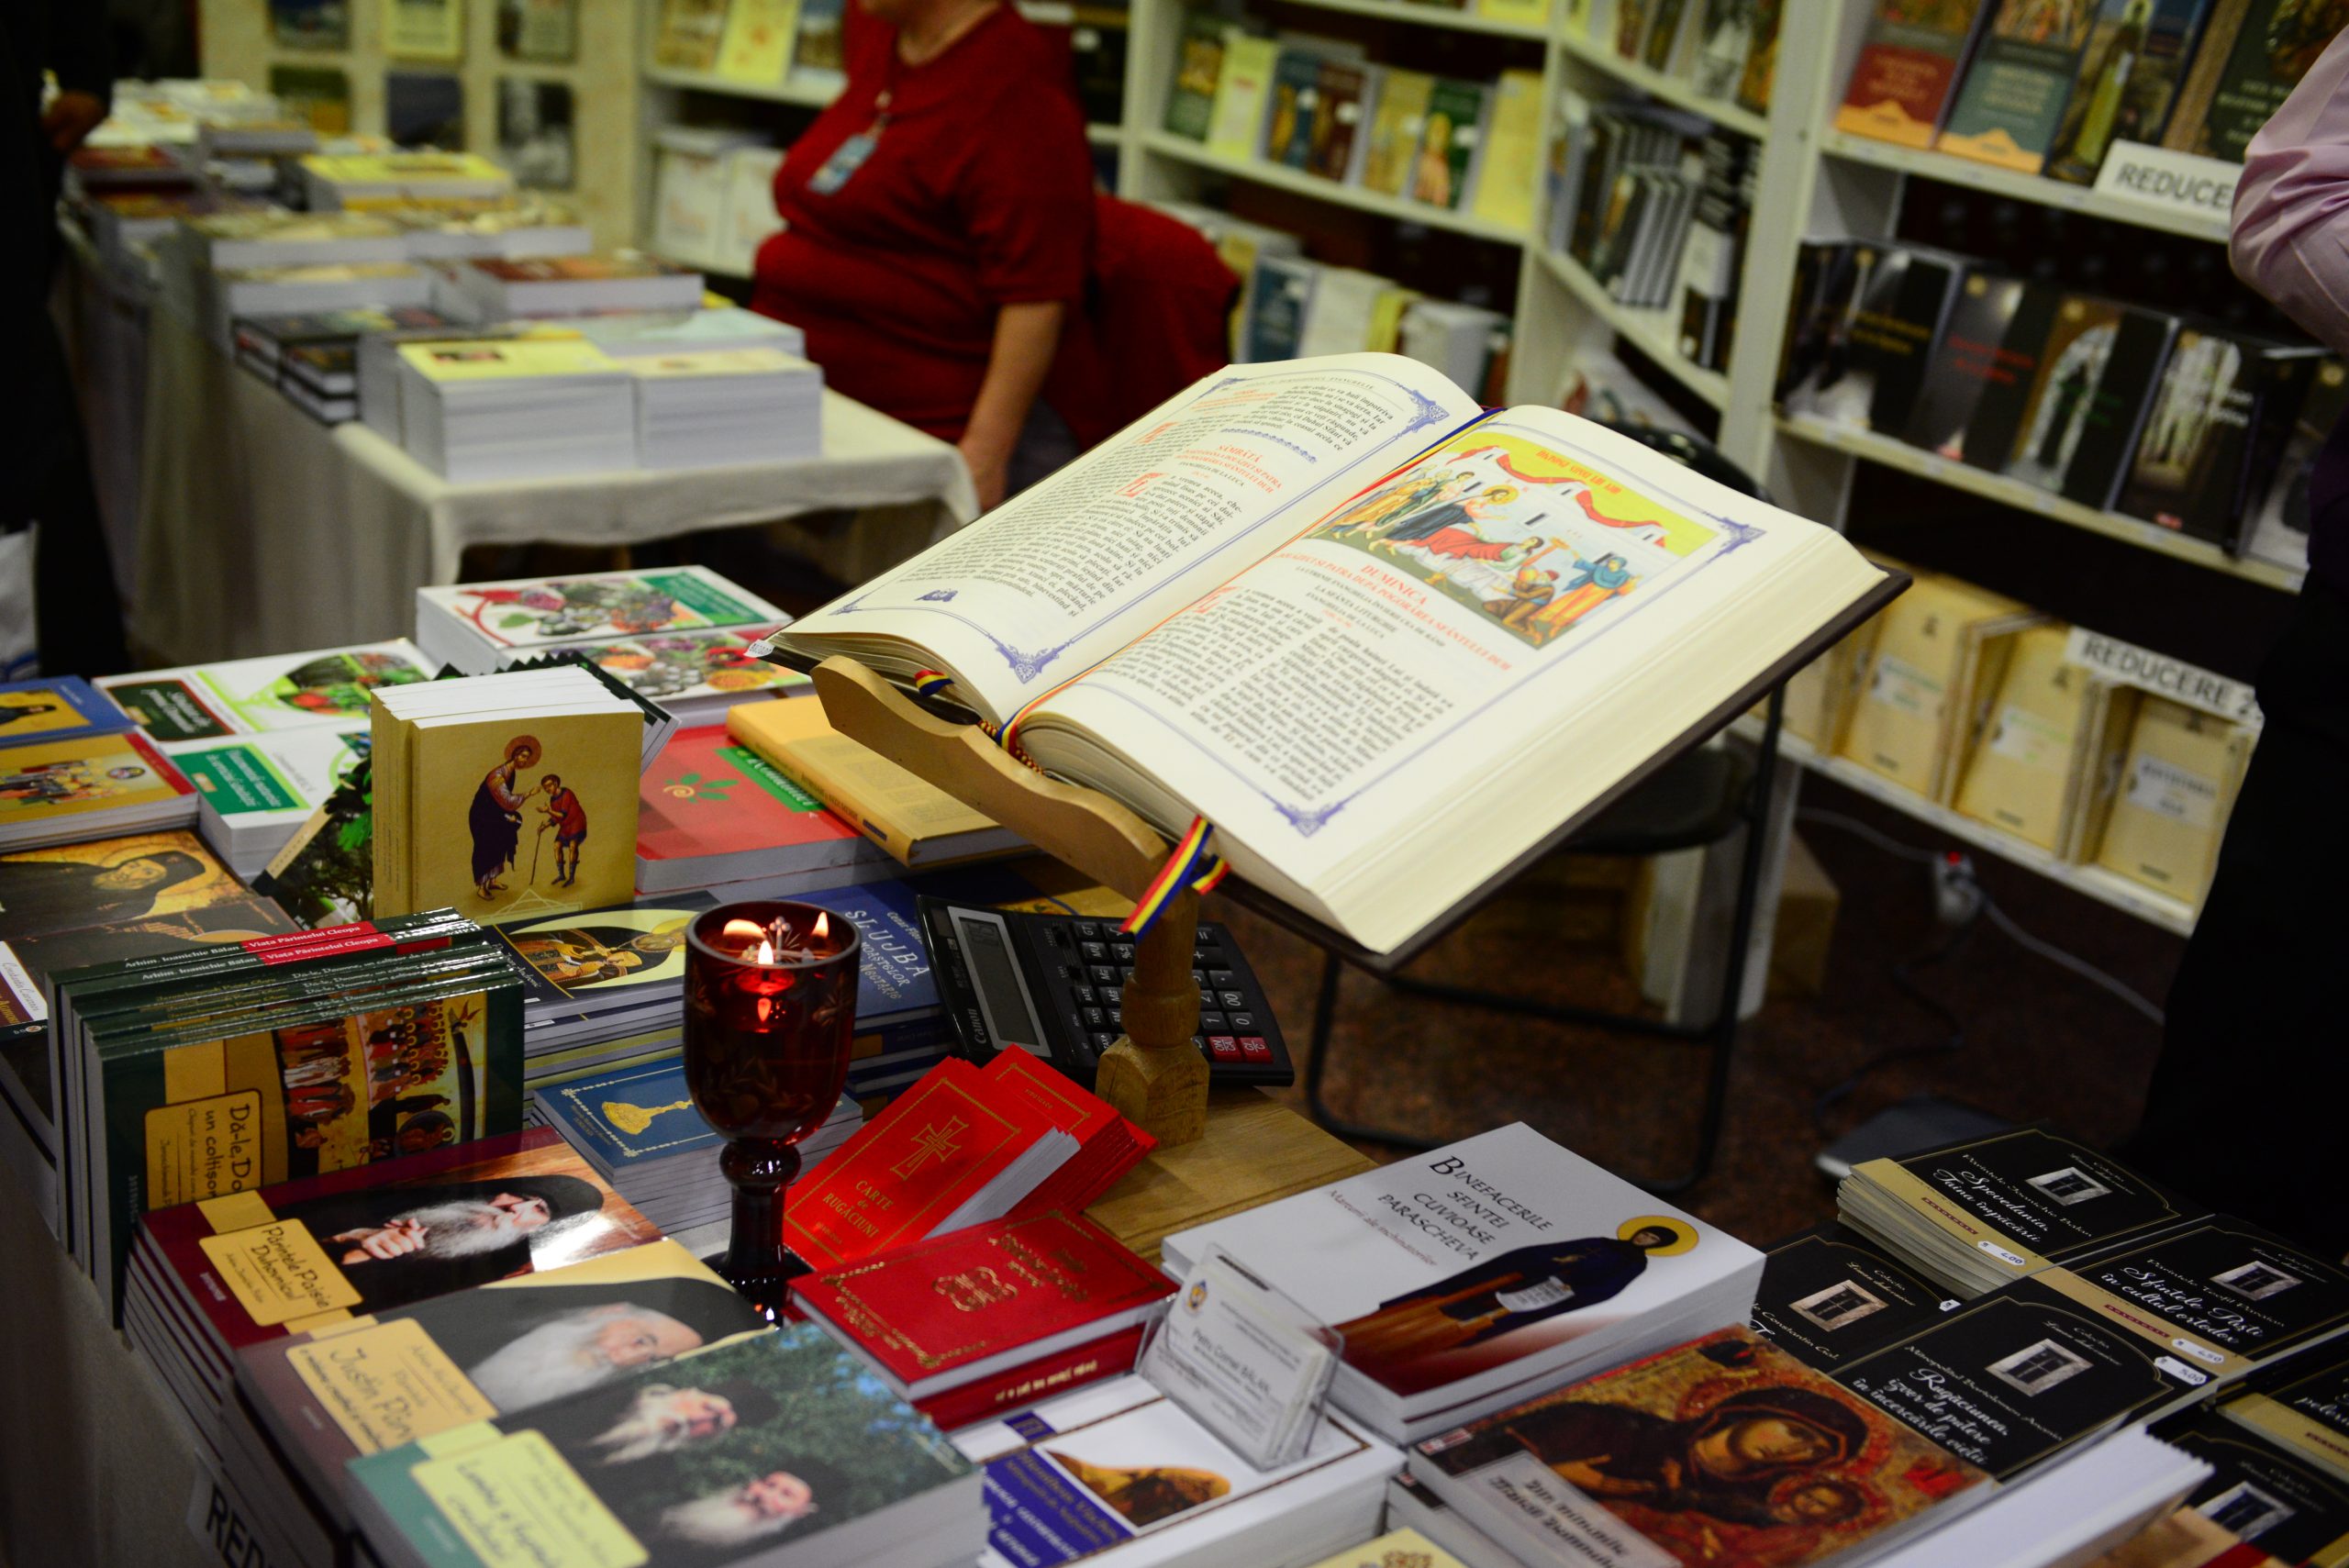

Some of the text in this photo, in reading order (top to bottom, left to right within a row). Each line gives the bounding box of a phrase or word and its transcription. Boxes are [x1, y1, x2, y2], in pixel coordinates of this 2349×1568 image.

[2118, 160, 2233, 209] REDUCE
[1102, 583, 1115, 594] din
[162, 949, 208, 966] Ioanichie
[327, 926, 361, 940] Cleopa
[345, 937, 379, 951] Cleopa
[845, 910, 930, 977] SLUJBA
[967, 1008, 987, 1044] Canon
[206, 1110, 215, 1131] un
[229, 1105, 250, 1158] Dă-le,
[855, 1180, 894, 1210] CARTE
[857, 1199, 869, 1209] de
[1429, 1155, 1553, 1232] BINEFACERILE
[1933, 1170, 1991, 1200] Taina
[1377, 1194, 1480, 1261] PARASCHEVA
[1413, 1193, 1497, 1245] CUVIOASE
[1446, 1191, 1510, 1229] SFINTEI
[295, 1270, 328, 1307] Paisie
[2124, 1267, 2202, 1307] Sfintele
[2122, 1284, 2183, 1311] cultul
[2176, 1314, 2232, 1341] ortodox
[1854, 1379, 1868, 1390] în
[1885, 1379, 1989, 1441] izvor de putere
[204, 1486, 273, 1568] RED
